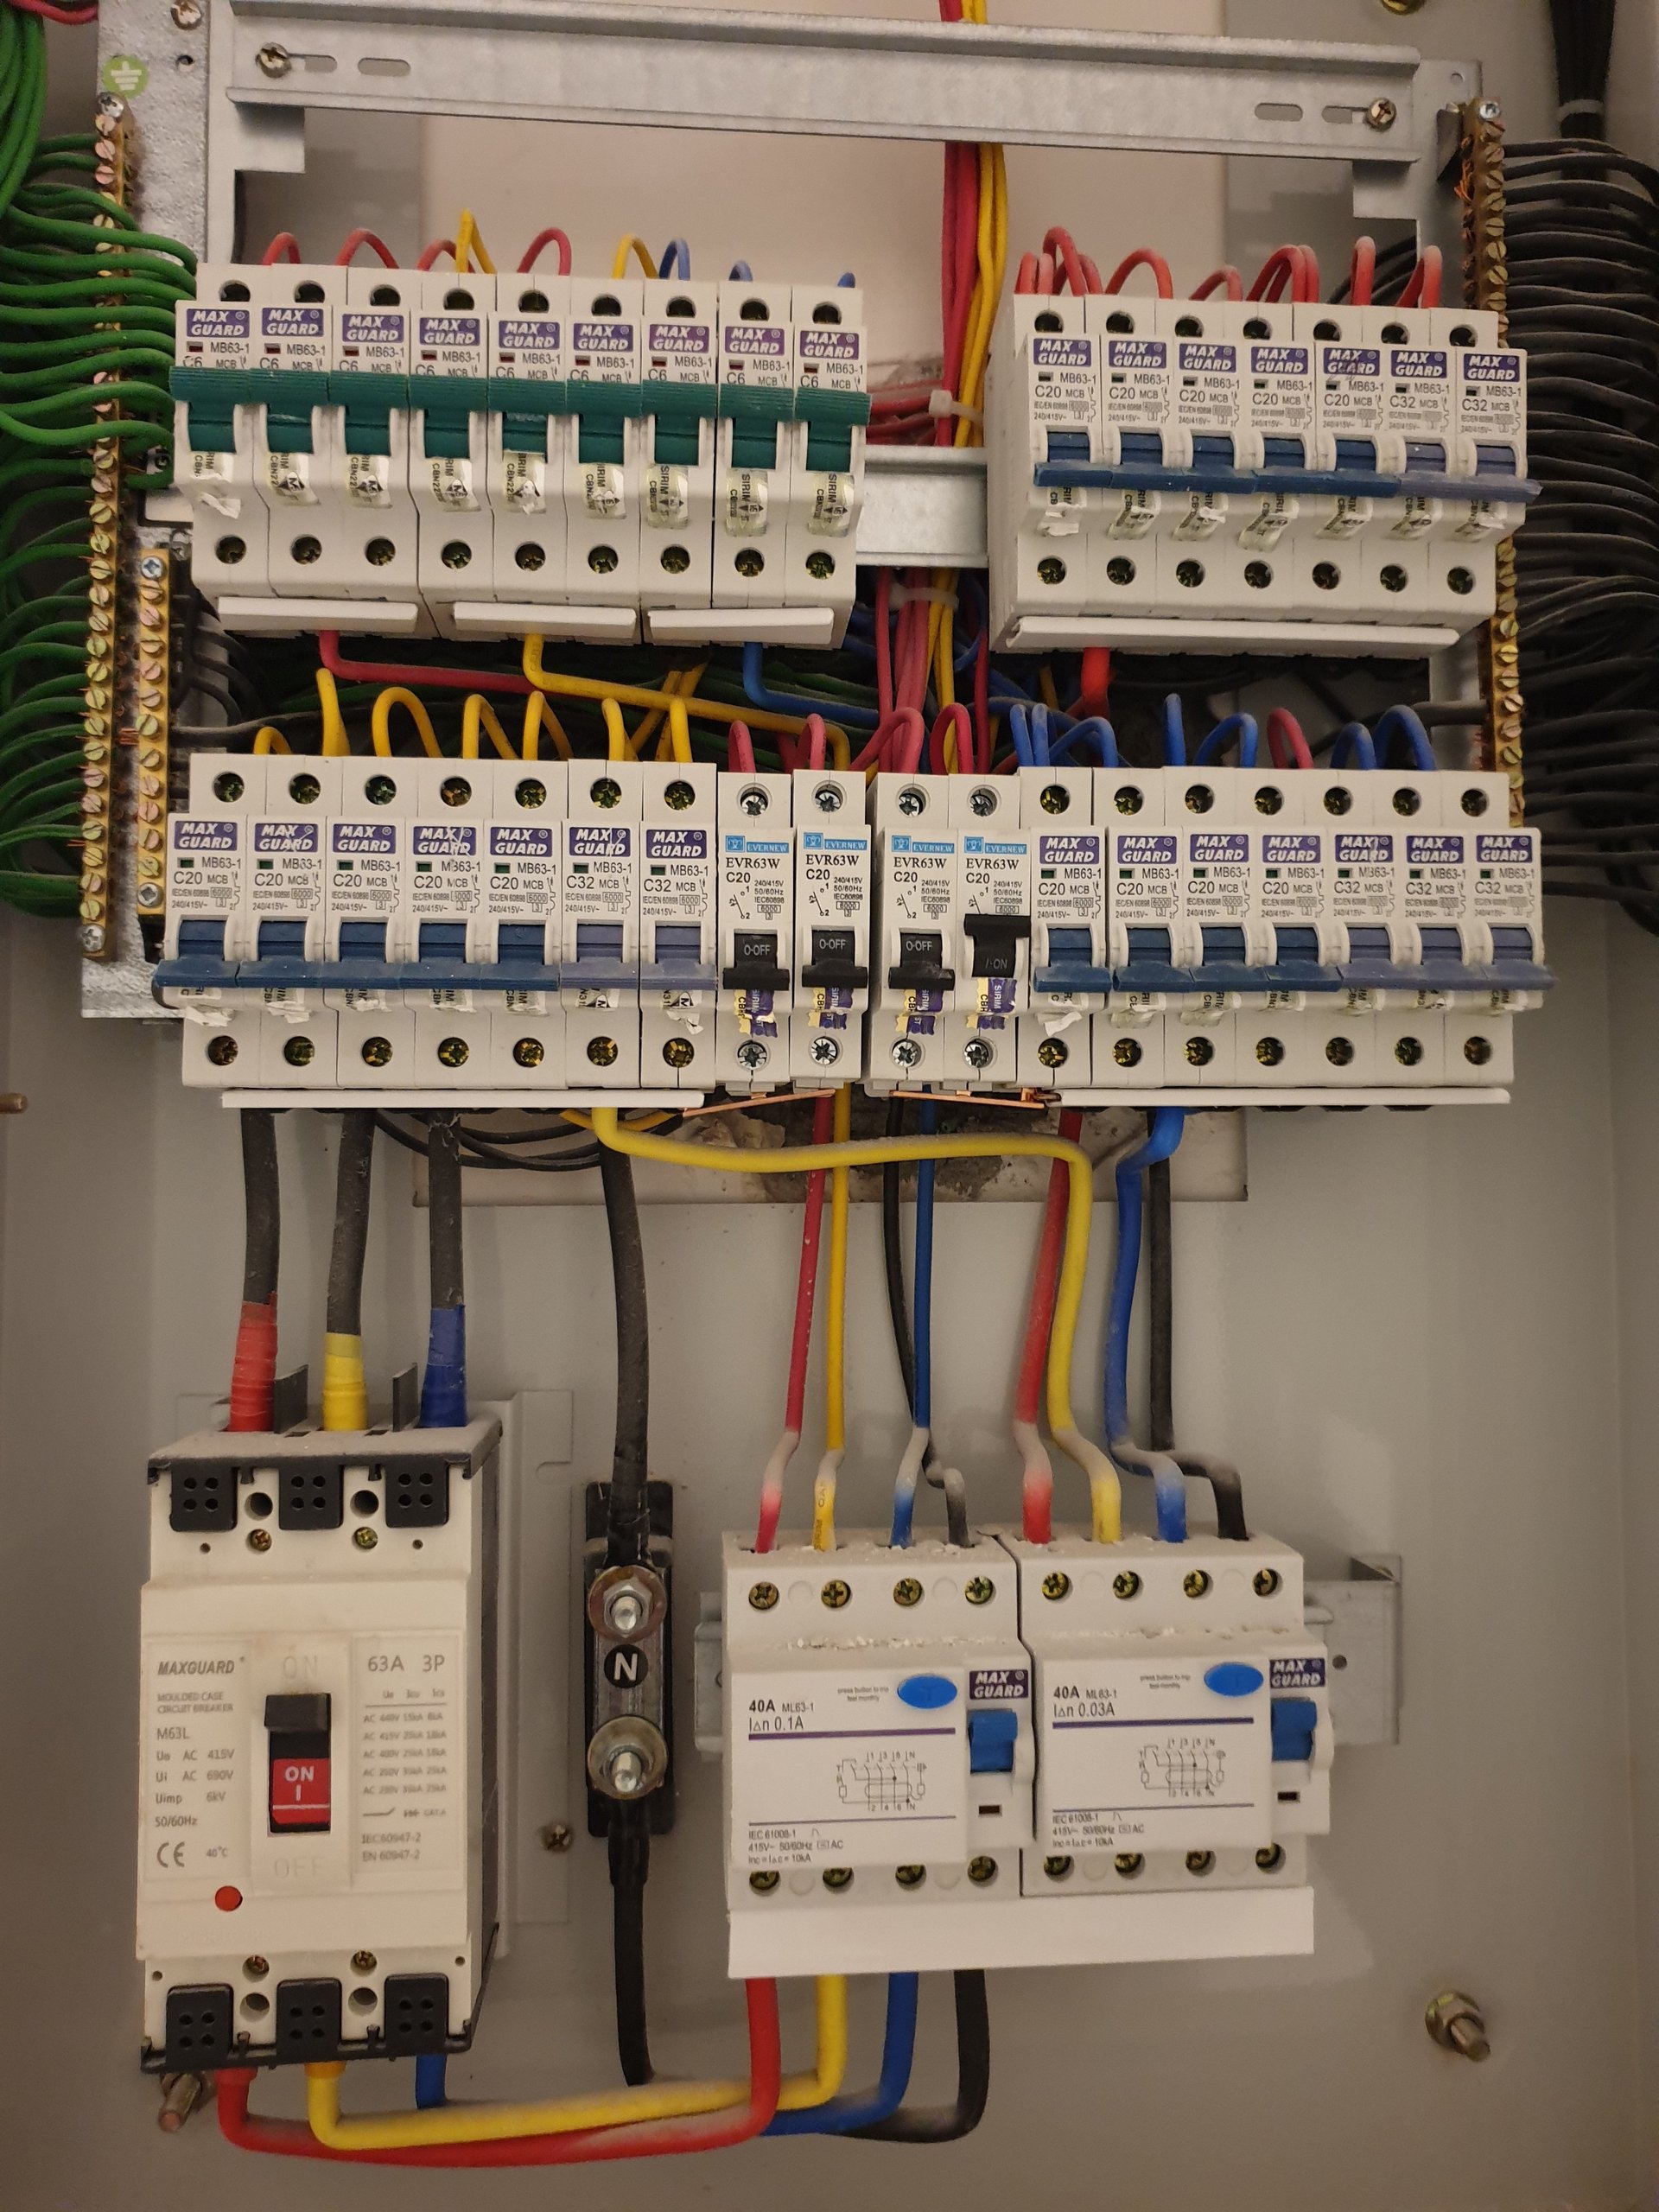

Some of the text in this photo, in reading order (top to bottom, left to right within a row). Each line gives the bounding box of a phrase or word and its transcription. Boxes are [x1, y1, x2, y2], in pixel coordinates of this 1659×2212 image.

[194, 309, 232, 321] MAX
[268, 308, 304, 321] MAX
[266, 321, 318, 335] GUARD
[348, 315, 385, 328] MAX
[426, 319, 461, 332] MAX
[192, 322, 245, 337] GUARD
[346, 328, 398, 342] GUARD
[505, 322, 541, 335] MAX
[580, 324, 615, 337] MAX
[655, 326, 690, 339] MAX
[424, 332, 474, 345] GUARD
[503, 335, 555, 349] GUARD
[731, 329, 766, 342] MAX
[806, 334, 841, 346] MAX
[210, 342, 249, 353] MB63-1
[287, 345, 325, 356] MB63-1
[578, 337, 628, 351] GUARD
[653, 339, 703, 353] GUARD
[729, 342, 779, 355] GUARD
[1039, 340, 1074, 353] MAX
[1115, 341, 1149, 354] MAX
[1185, 344, 1219, 356] MAX
[366, 346, 404, 358] MB63-1
[442, 351, 480, 363] MB63-1
[804, 346, 855, 359] GUARD
[1257, 347, 1291, 359] MAX
[1329, 349, 1363, 361] MAX
[1396, 351, 1429, 363] MAX
[522, 353, 561, 365] MB63-1
[596, 356, 634, 368] MB63-1
[674, 356, 712, 368] MB63-1
[753, 359, 791, 372] MB63-1
[1038, 353, 1087, 366] GUARD
[1113, 354, 1162, 368] GUARD
[1184, 357, 1232, 372] GUARD
[1467, 355, 1502, 368] MAX
[826, 363, 864, 375] MB63-1
[1255, 360, 1304, 375] GUARD
[1395, 364, 1442, 377] GUARD
[648, 369, 667, 382] C6
[727, 372, 746, 385] C6
[1059, 373, 1096, 385] MB63-1
[1134, 373, 1170, 385] MB63-1
[1465, 368, 1515, 382] GUARD
[800, 376, 819, 389] C6
[1205, 377, 1240, 389] MB63-1
[1277, 380, 1313, 391] MB63-1
[1349, 380, 1383, 391] MB63-1
[1414, 383, 1450, 394] MB63-1
[1035, 386, 1061, 397] C20
[1109, 387, 1135, 399] C20
[1179, 391, 1205, 403] C20
[1253, 393, 1278, 404] C20
[1324, 394, 1350, 406] C20
[1389, 396, 1415, 408] C32
[1462, 399, 1488, 411] C32
[181, 822, 219, 835] MAX
[261, 824, 299, 836] MAX
[339, 825, 377, 838] MAX
[419, 827, 457, 840] MAX
[496, 828, 533, 840] MAX
[575, 828, 612, 840] MAX
[179, 835, 232, 849] GUARD
[652, 830, 690, 843] MAX
[1046, 836, 1081, 849] MAX
[1123, 836, 1159, 849] MAX
[1196, 835, 1230, 847] MAX
[1268, 836, 1303, 849] MAX
[1341, 836, 1376, 849] MAX
[1413, 836, 1446, 849] MAX
[1481, 836, 1515, 849] MAX
[259, 837, 313, 852] GUARD
[337, 838, 391, 852] GUARD
[417, 840, 471, 854] GUARD
[494, 841, 547, 855] GUARD
[574, 841, 626, 855] GUARD
[651, 843, 704, 857] GUARD
[747, 843, 788, 852] EVERNEW
[913, 843, 954, 852] EVERNEW
[986, 845, 1026, 854] EVERNEW
[805, 855, 859, 866] EVR63W
[1044, 849, 1094, 864] GUARD
[1122, 849, 1172, 864] GUARD
[1194, 848, 1244, 862] GUARD
[1267, 849, 1316, 862] GUARD
[1339, 849, 1389, 862] GUARD
[1411, 849, 1459, 864] GUARD
[1480, 849, 1528, 862] GUARD
[202, 857, 241, 869] MB63-1
[361, 859, 400, 871] MB63-1
[518, 863, 556, 874] MB63-1
[594, 862, 632, 874] MB63-1
[726, 857, 780, 869] EVR63W
[893, 857, 947, 868] EVR63W
[966, 858, 1020, 869] EVR63W
[671, 864, 709, 876] MB63-1
[806, 869, 830, 880] C20
[1065, 868, 1101, 880] MB63-1
[1142, 868, 1179, 880] MB63-1
[1213, 868, 1250, 878] MB63-1
[1287, 868, 1324, 878] MB63-1
[1431, 868, 1465, 880] MB63-1
[174, 872, 202, 885] C20
[254, 874, 283, 887] C20
[334, 874, 361, 887] C20
[414, 876, 442, 888] C20
[490, 876, 518, 890] C20
[567, 876, 594, 889] C32
[726, 872, 750, 883] C20
[893, 872, 918, 883] C20
[966, 873, 990, 884] C20
[643, 879, 671, 892] C32
[1039, 883, 1065, 895] C20
[1116, 883, 1143, 895] C20
[1187, 881, 1215, 893] C20
[1262, 882, 1289, 895] C20
[1334, 881, 1360, 893] C32
[1406, 882, 1432, 895] C32
[1475, 881, 1500, 893] C32
[157, 1660, 235, 1675] MAXGUARD
[368, 1654, 445, 1672] 63A 3P
[613, 1652, 638, 1681] N
[1273, 1661, 1306, 1673] MAX
[975, 1671, 1009, 1683] MAX
[1272, 1673, 1321, 1686] GUARD
[973, 1684, 1024, 1698] GUARD
[1053, 1685, 1080, 1699] 40A
[748, 1699, 814, 1713] 40A ML63-1
[1078, 1702, 1115, 1718] 0.03A
[774, 1716, 804, 1731] 0.1A
[157, 1726, 190, 1740] M63L
[183, 1751, 198, 1761] AC
[285, 1766, 315, 1782] ON
